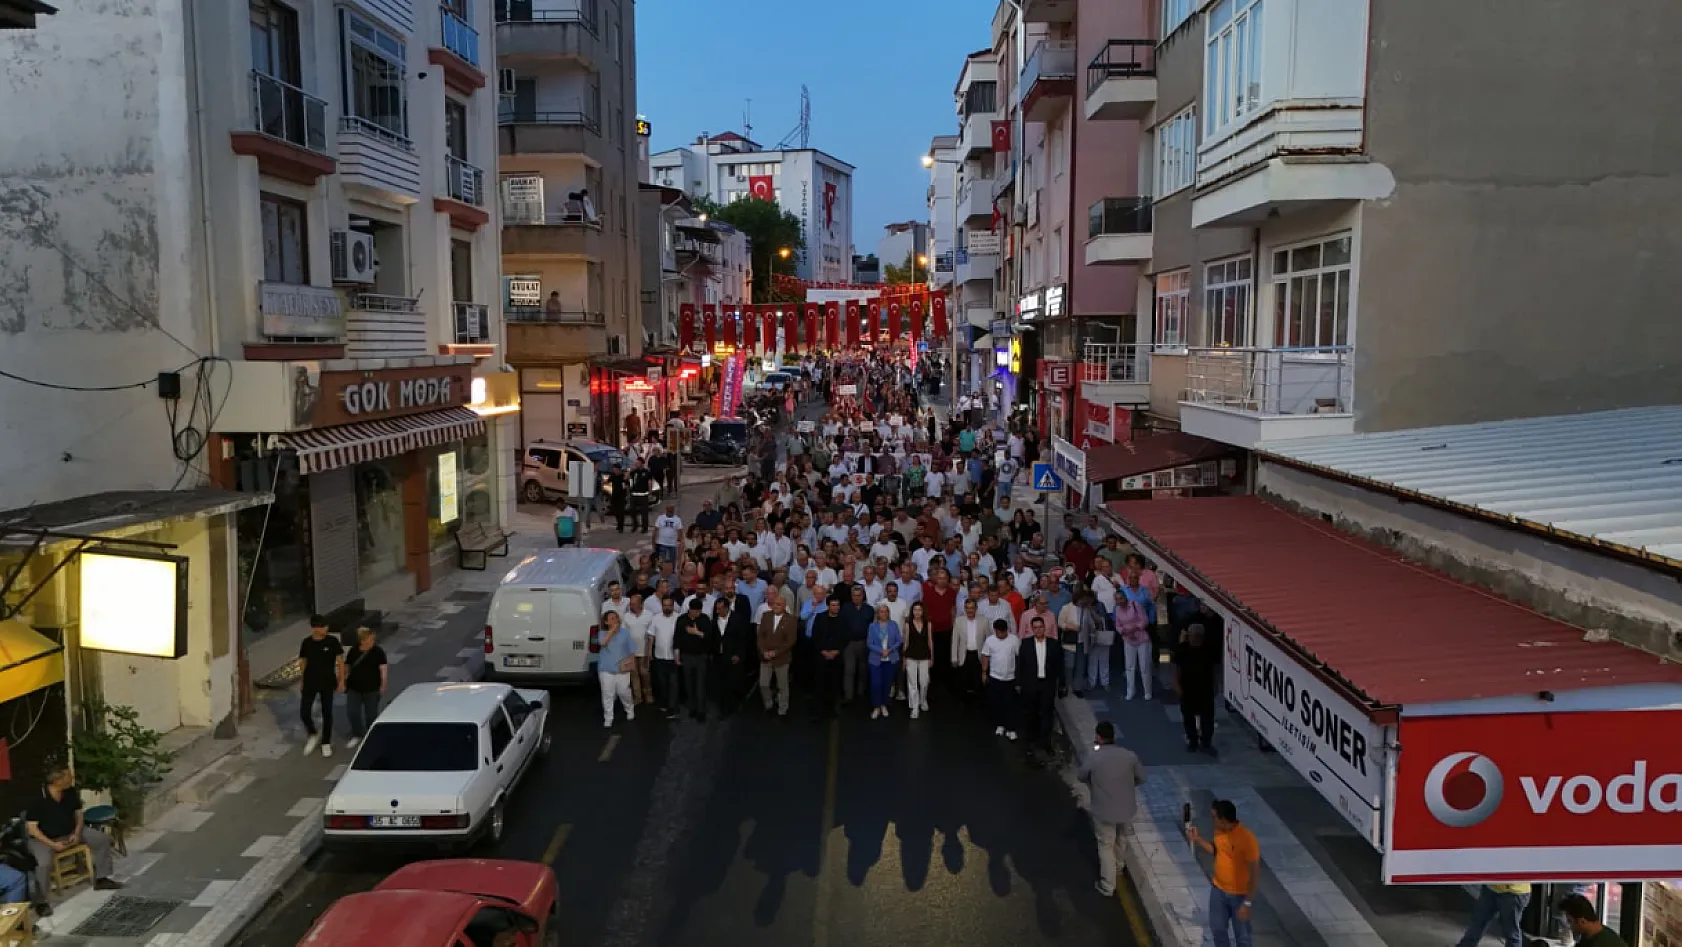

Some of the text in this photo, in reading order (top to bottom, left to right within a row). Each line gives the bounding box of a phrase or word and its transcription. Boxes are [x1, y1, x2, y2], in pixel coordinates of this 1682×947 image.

[511, 282, 540, 291] AVUKAT
[345, 372, 450, 414] GÖK MODA
[1245, 642, 1367, 776] TEKNO SONER
[1519, 760, 1682, 814] voda
